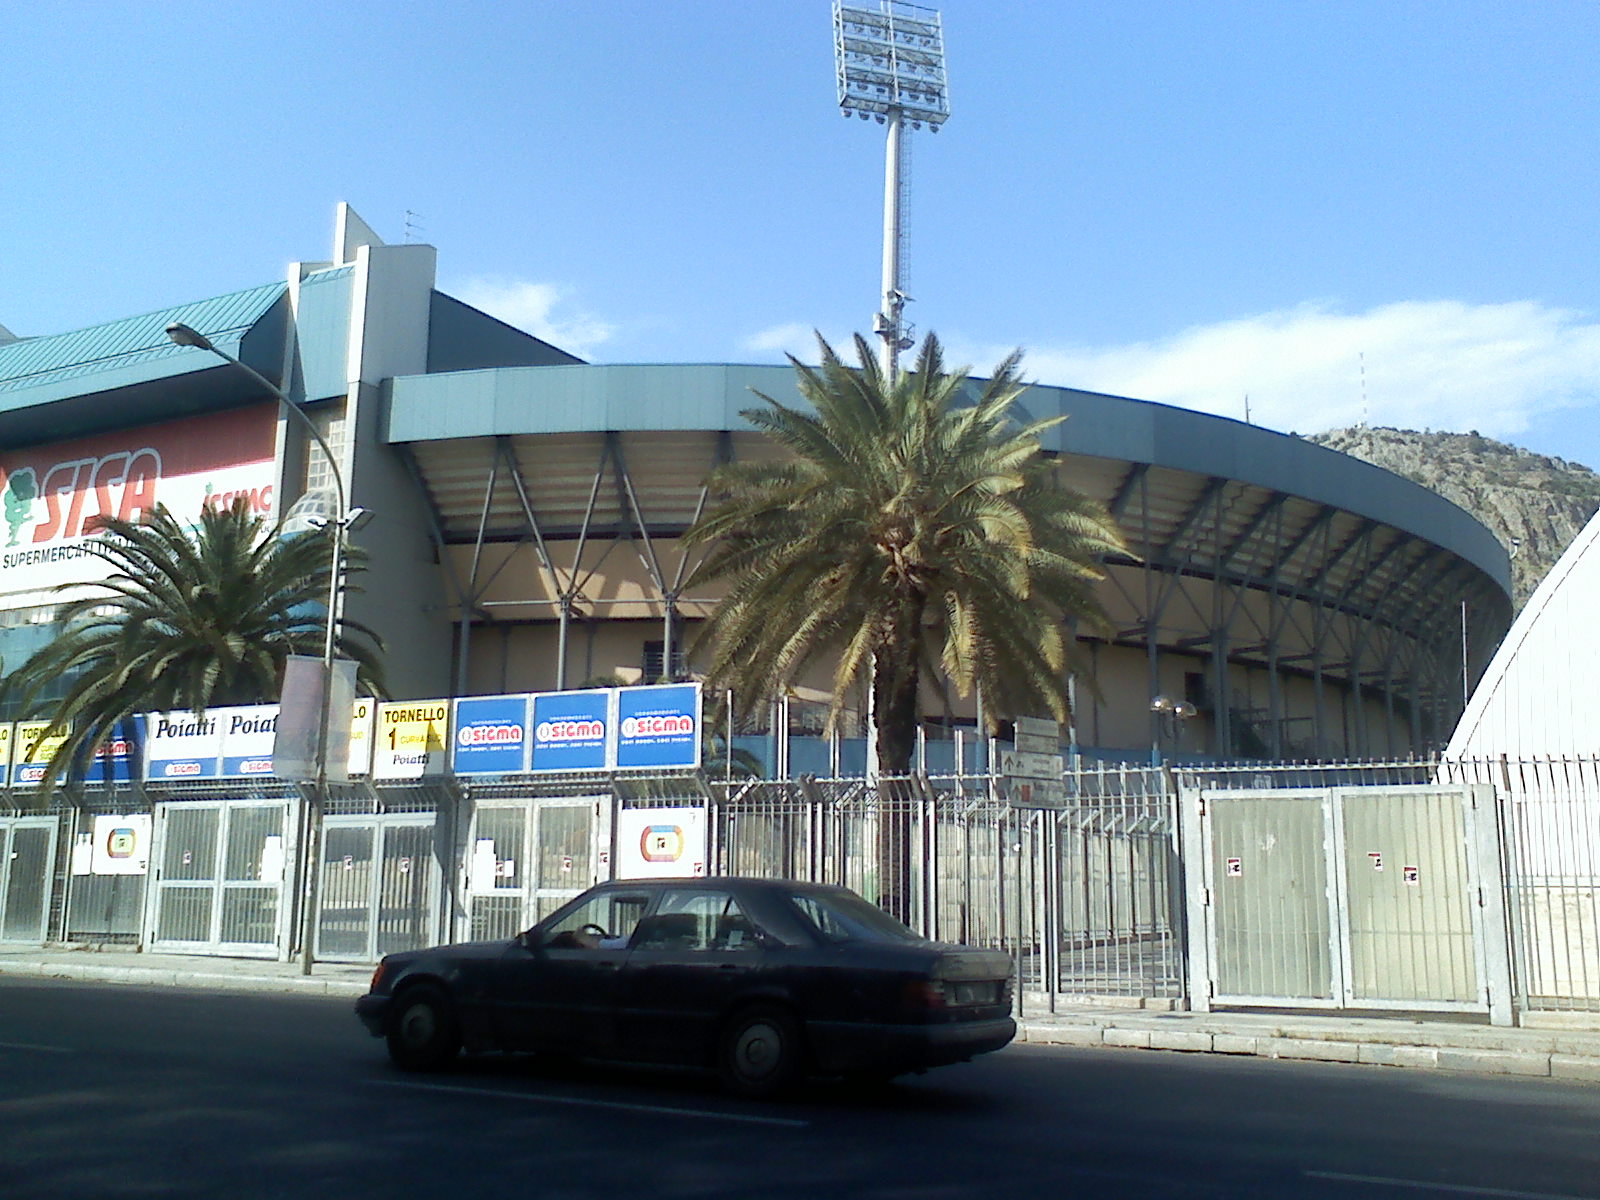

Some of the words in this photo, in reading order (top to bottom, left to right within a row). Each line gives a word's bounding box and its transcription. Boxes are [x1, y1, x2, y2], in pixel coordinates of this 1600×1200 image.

[32, 447, 162, 543] SISA
[2, 542, 95, 569] SUPERMERCATI
[230, 714, 279, 734] Poiat
[385, 707, 445, 723] TORNELLO
[156, 717, 216, 738] Poiatti
[389, 728, 397, 751] 1
[393, 753, 430, 765] Poiatti
